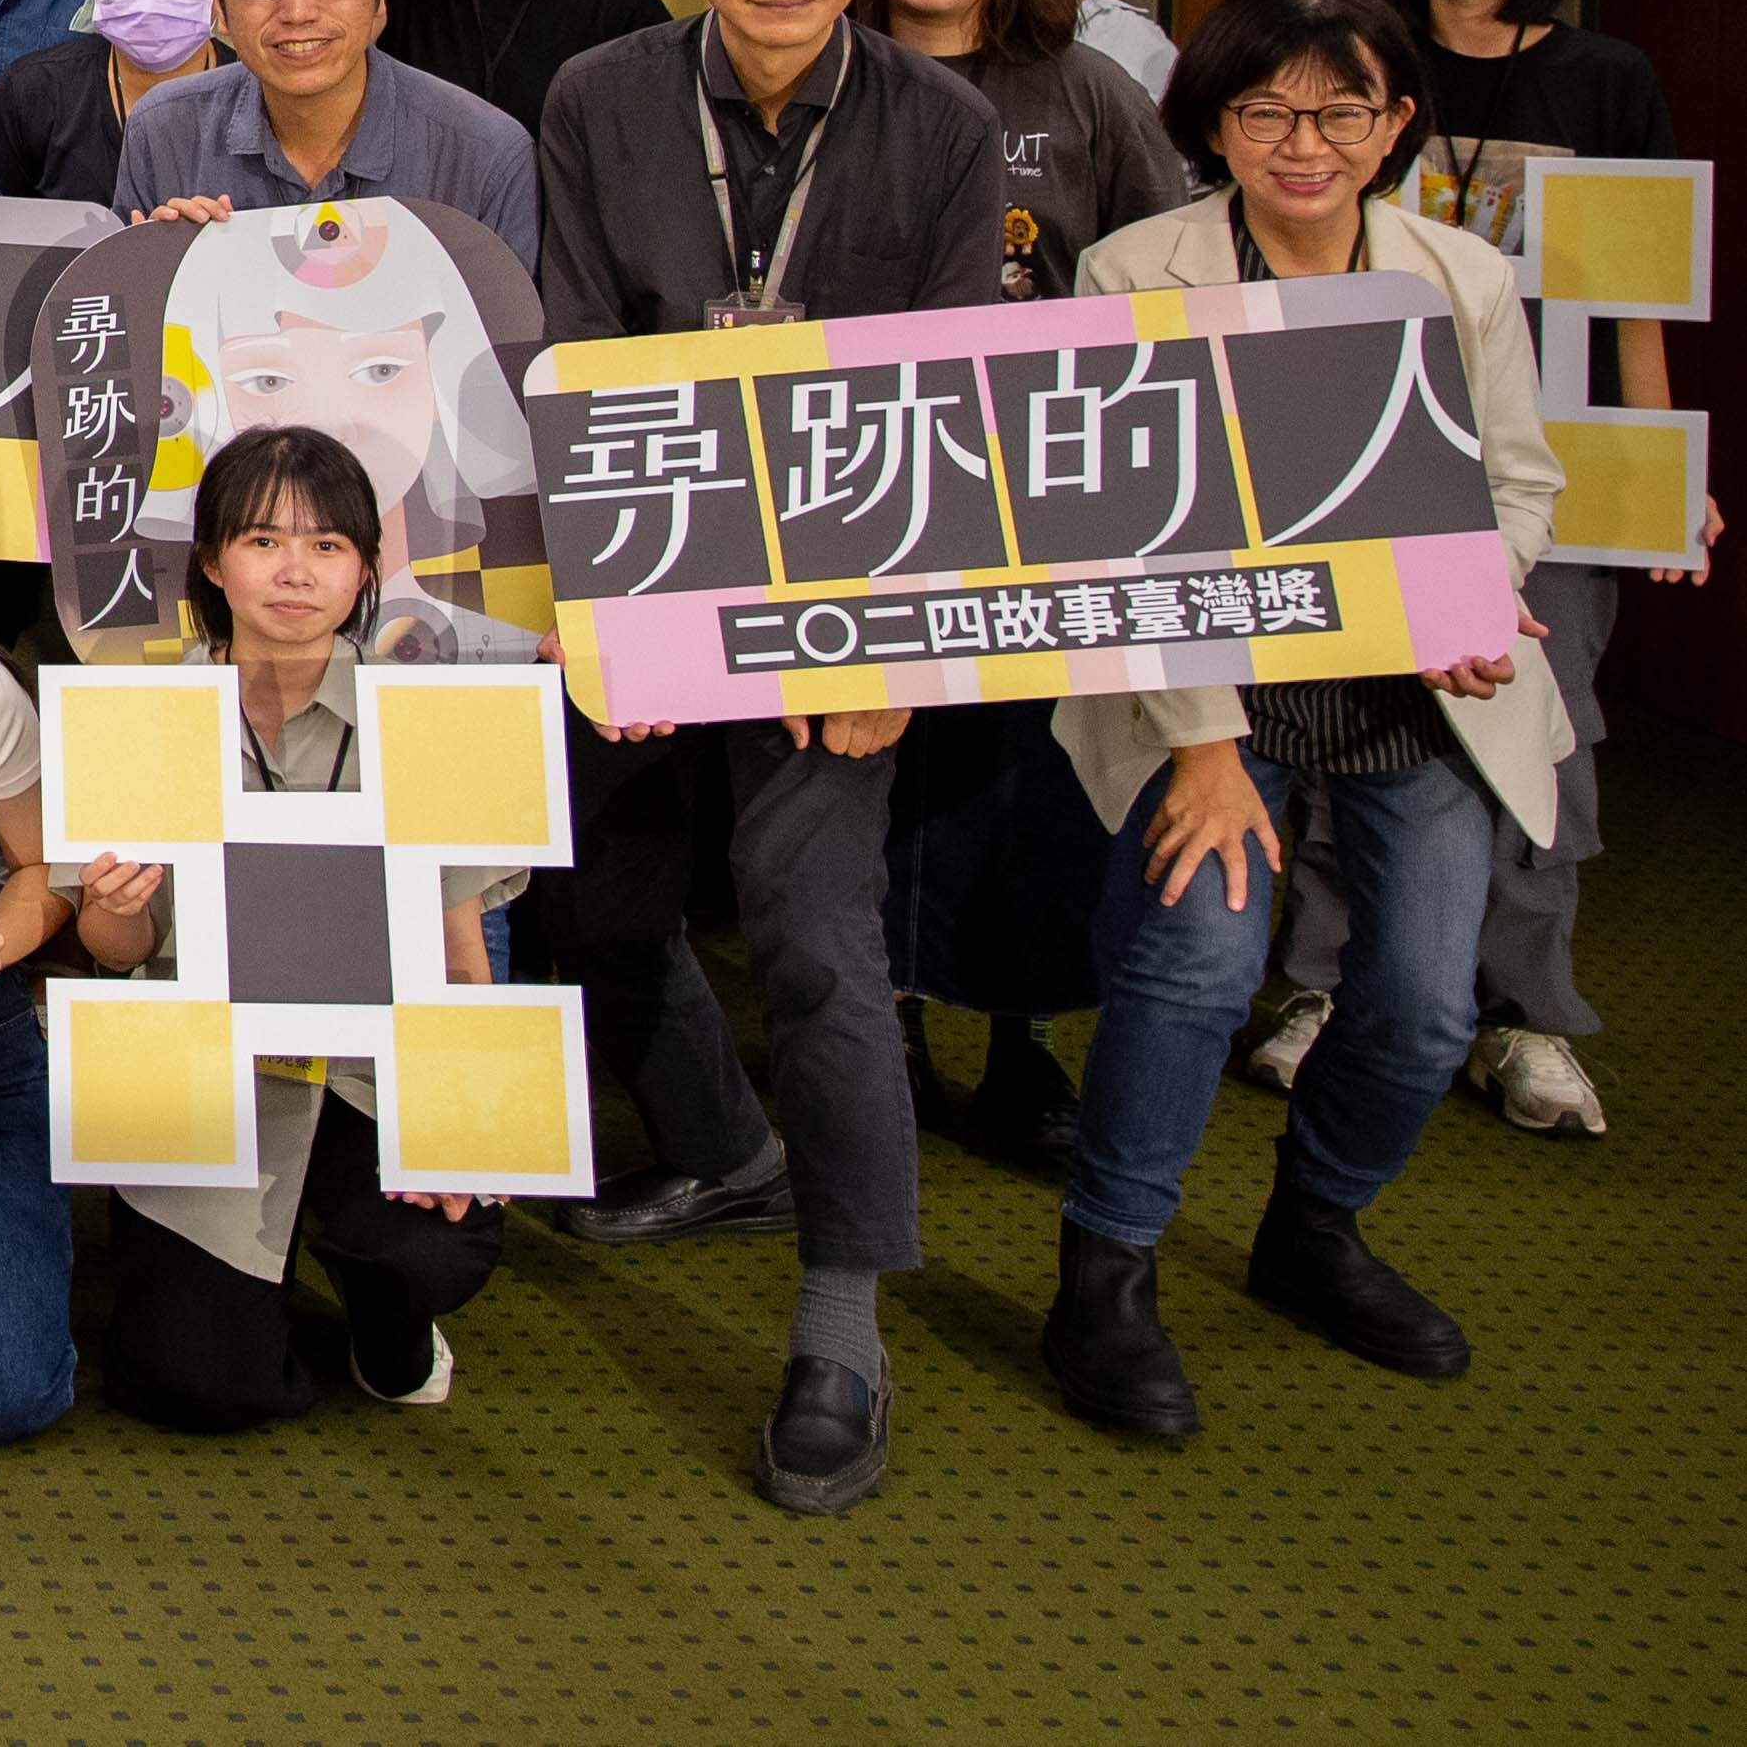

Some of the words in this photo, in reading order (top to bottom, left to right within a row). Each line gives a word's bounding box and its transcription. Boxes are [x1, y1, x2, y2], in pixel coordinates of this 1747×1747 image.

[1007, 164, 1043, 177] time
[57, 295, 153, 632] 尋跡的人
[549, 316, 1481, 596] 尋跡的人
